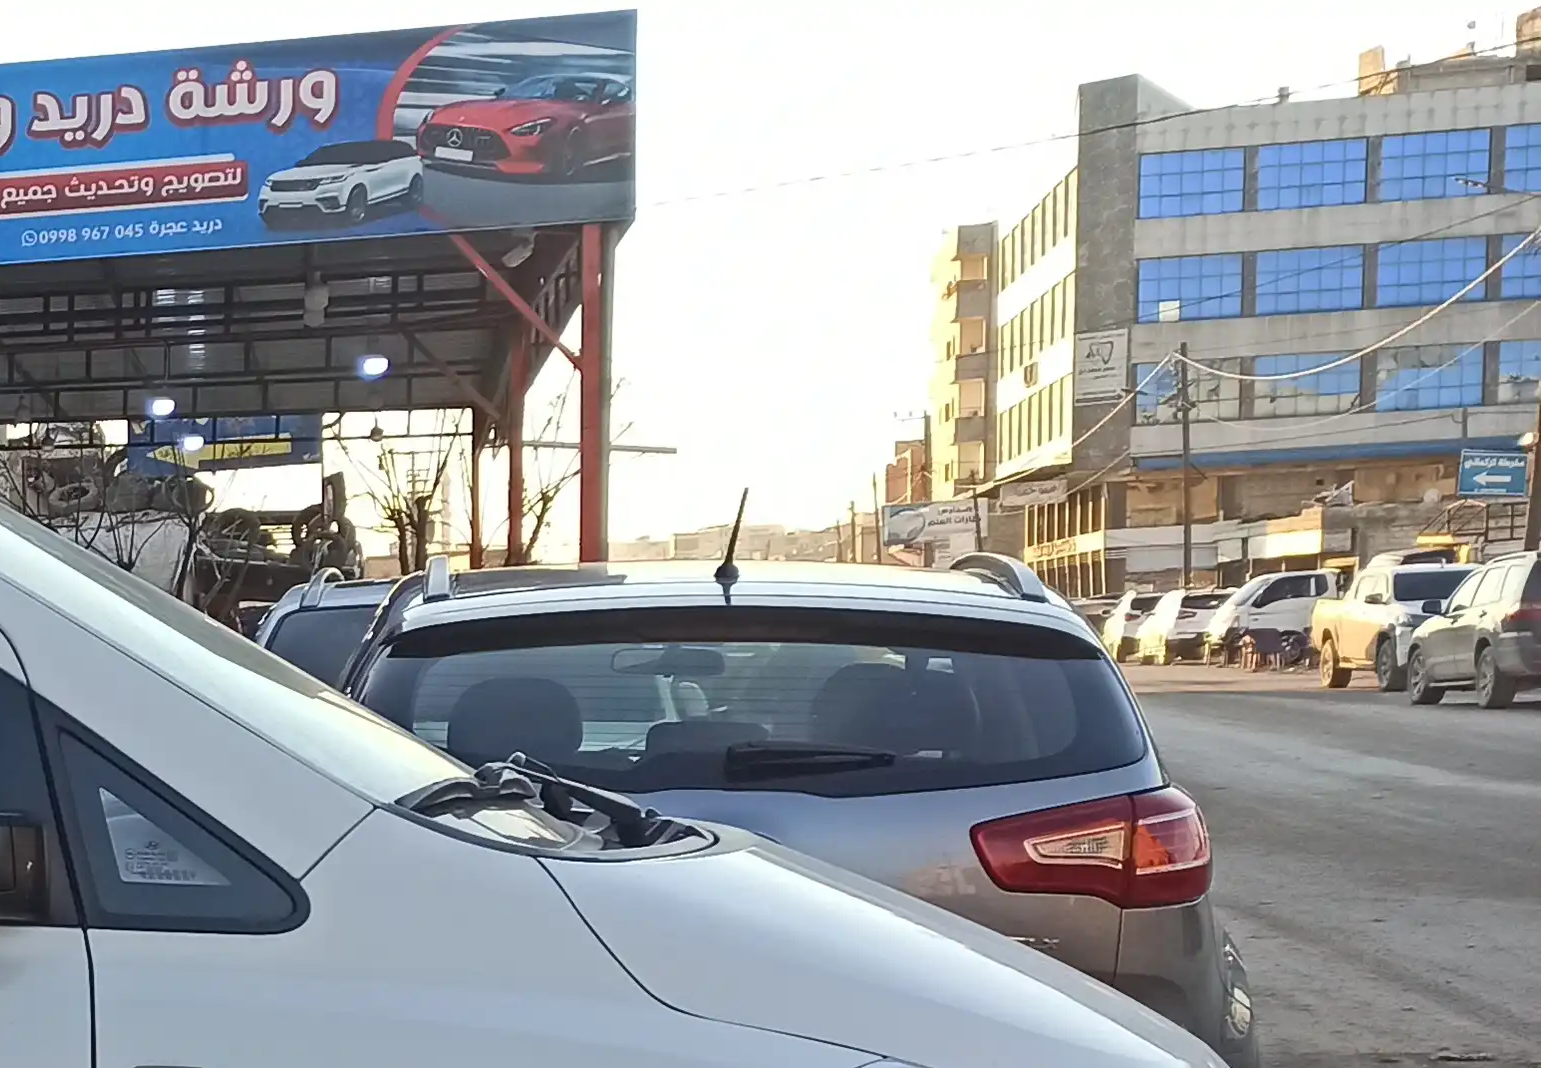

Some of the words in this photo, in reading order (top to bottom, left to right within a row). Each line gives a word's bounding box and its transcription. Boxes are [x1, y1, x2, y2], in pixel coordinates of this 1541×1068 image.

[168, 60, 337, 128] ورشة
[30, 85, 146, 142] دريد
[64, 175, 154, 200] وتحديث
[161, 167, 243, 197] لتصويج
[0, 182, 58, 209] جميع
[38, 228, 77, 245] 0998
[81, 226, 110, 242] 967
[114, 223, 145, 239] 045
[149, 220, 188, 238] عجرة
[191, 218, 223, 233] دريد
